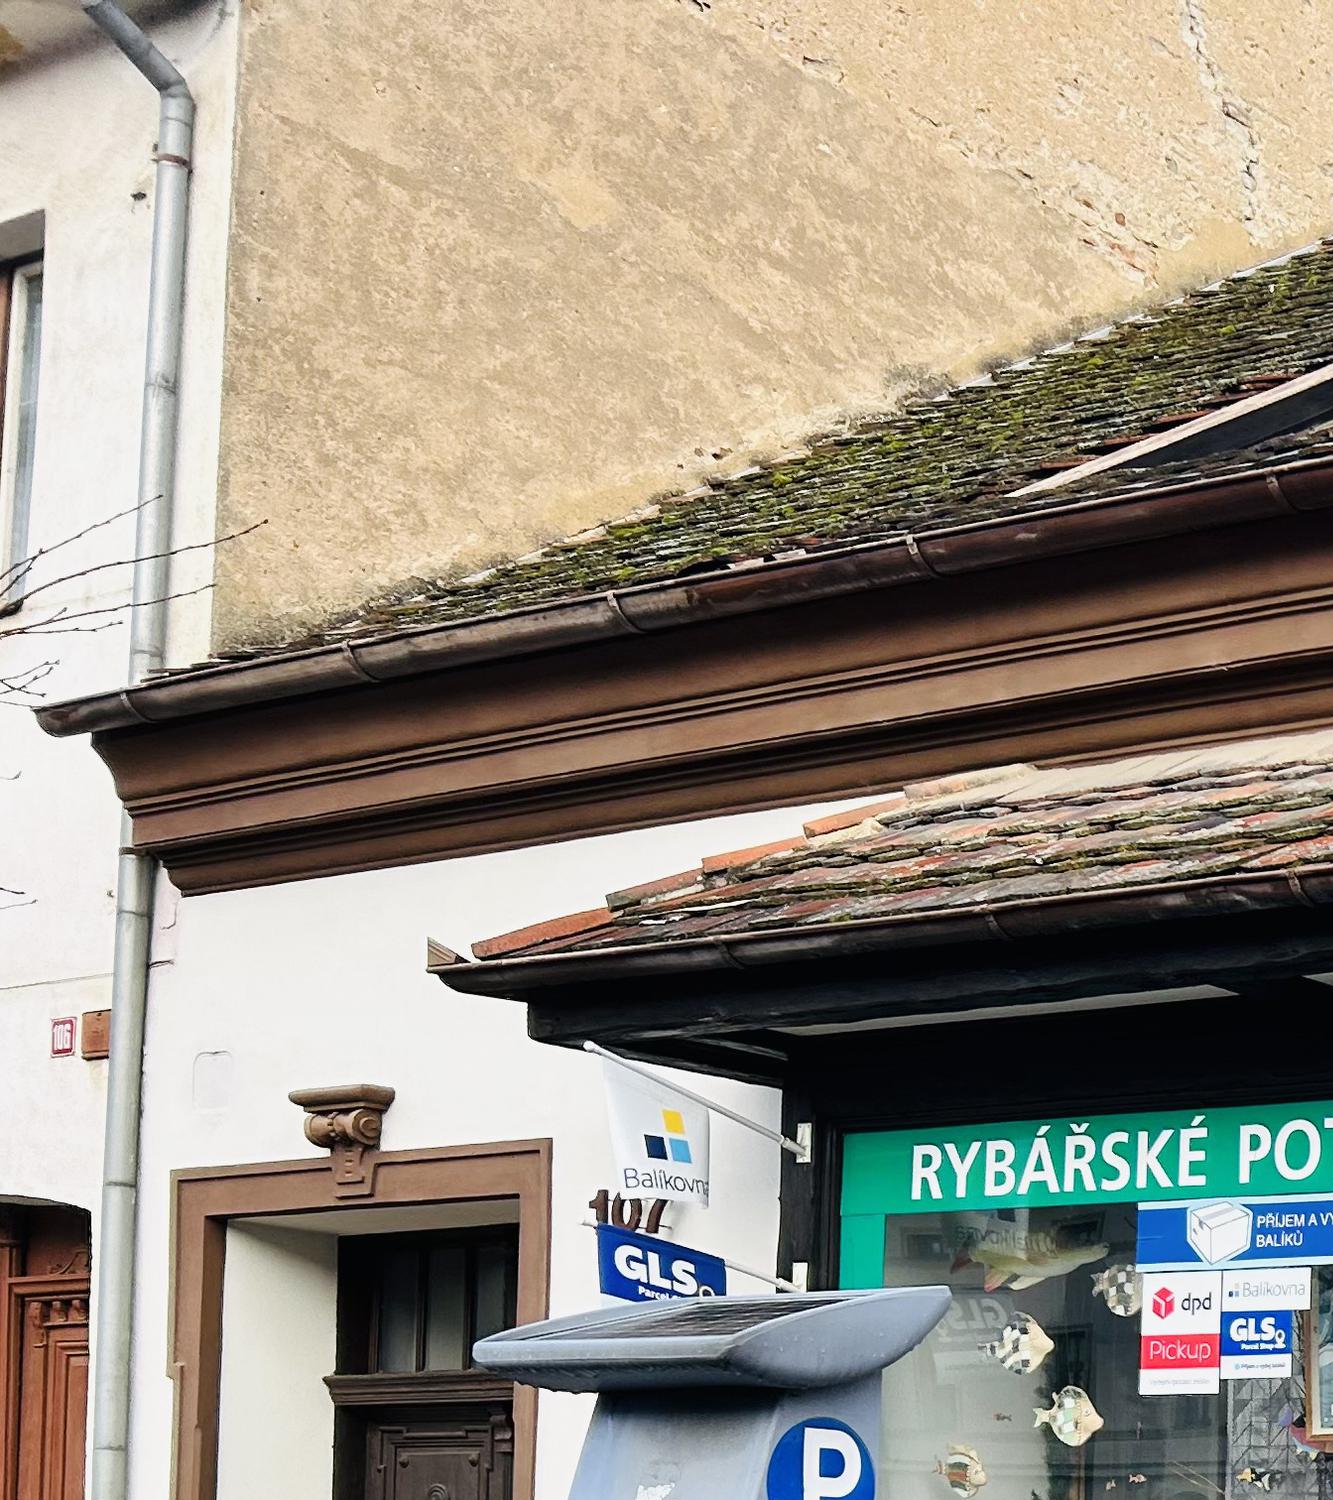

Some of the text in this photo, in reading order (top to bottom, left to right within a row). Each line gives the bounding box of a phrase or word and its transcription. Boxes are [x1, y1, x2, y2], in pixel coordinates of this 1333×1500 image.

[910, 1115, 1208, 1201] RYBÁŘSKÉ
[588, 1189, 670, 1234] 107
[1256, 1211, 1306, 1229] PŘÍJEM
[1307, 1213, 1318, 1226] A
[1256, 1231, 1304, 1248] BALÍKŮ
[614, 1244, 699, 1296] GLS
[1180, 1291, 1212, 1315] dpd
[1229, 1316, 1276, 1343] GLS
[1149, 1339, 1211, 1365] Pickup
